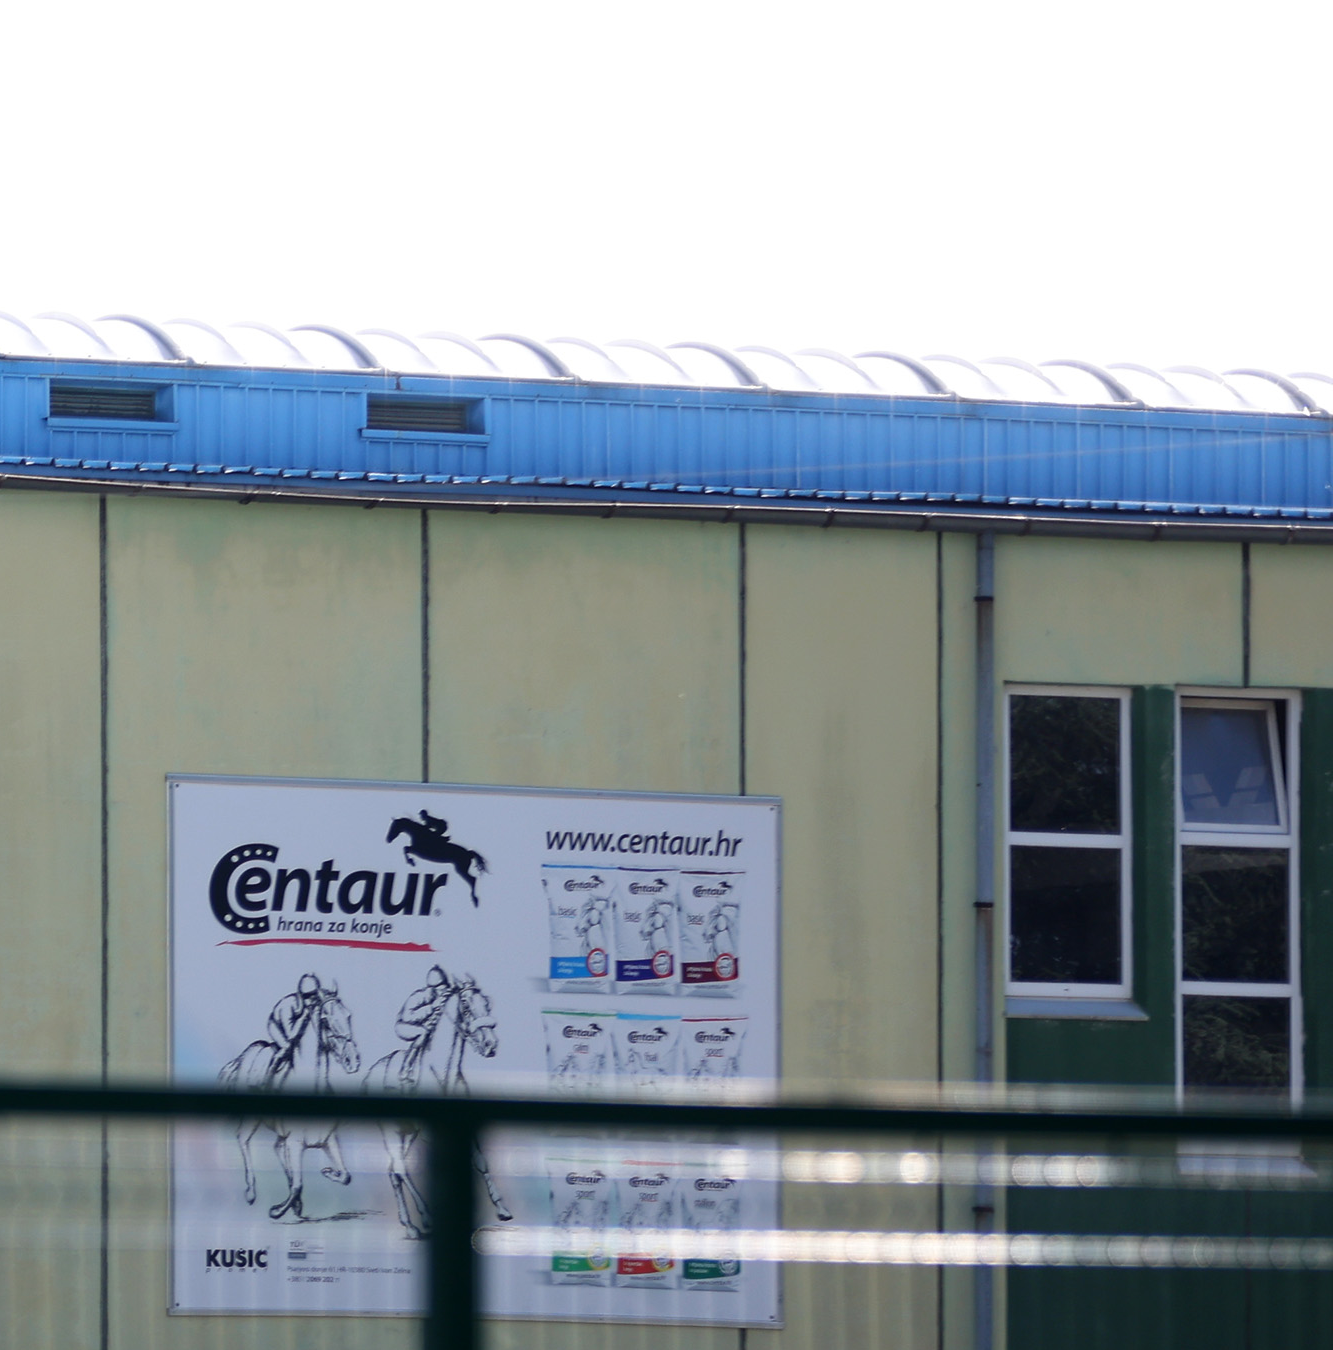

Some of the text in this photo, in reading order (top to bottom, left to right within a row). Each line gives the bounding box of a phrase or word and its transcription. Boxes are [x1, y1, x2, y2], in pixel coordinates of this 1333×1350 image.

[546, 830, 742, 857] www.centaur.hr
[209, 843, 448, 934] Centaur
[277, 917, 392, 938] hrana za konje
